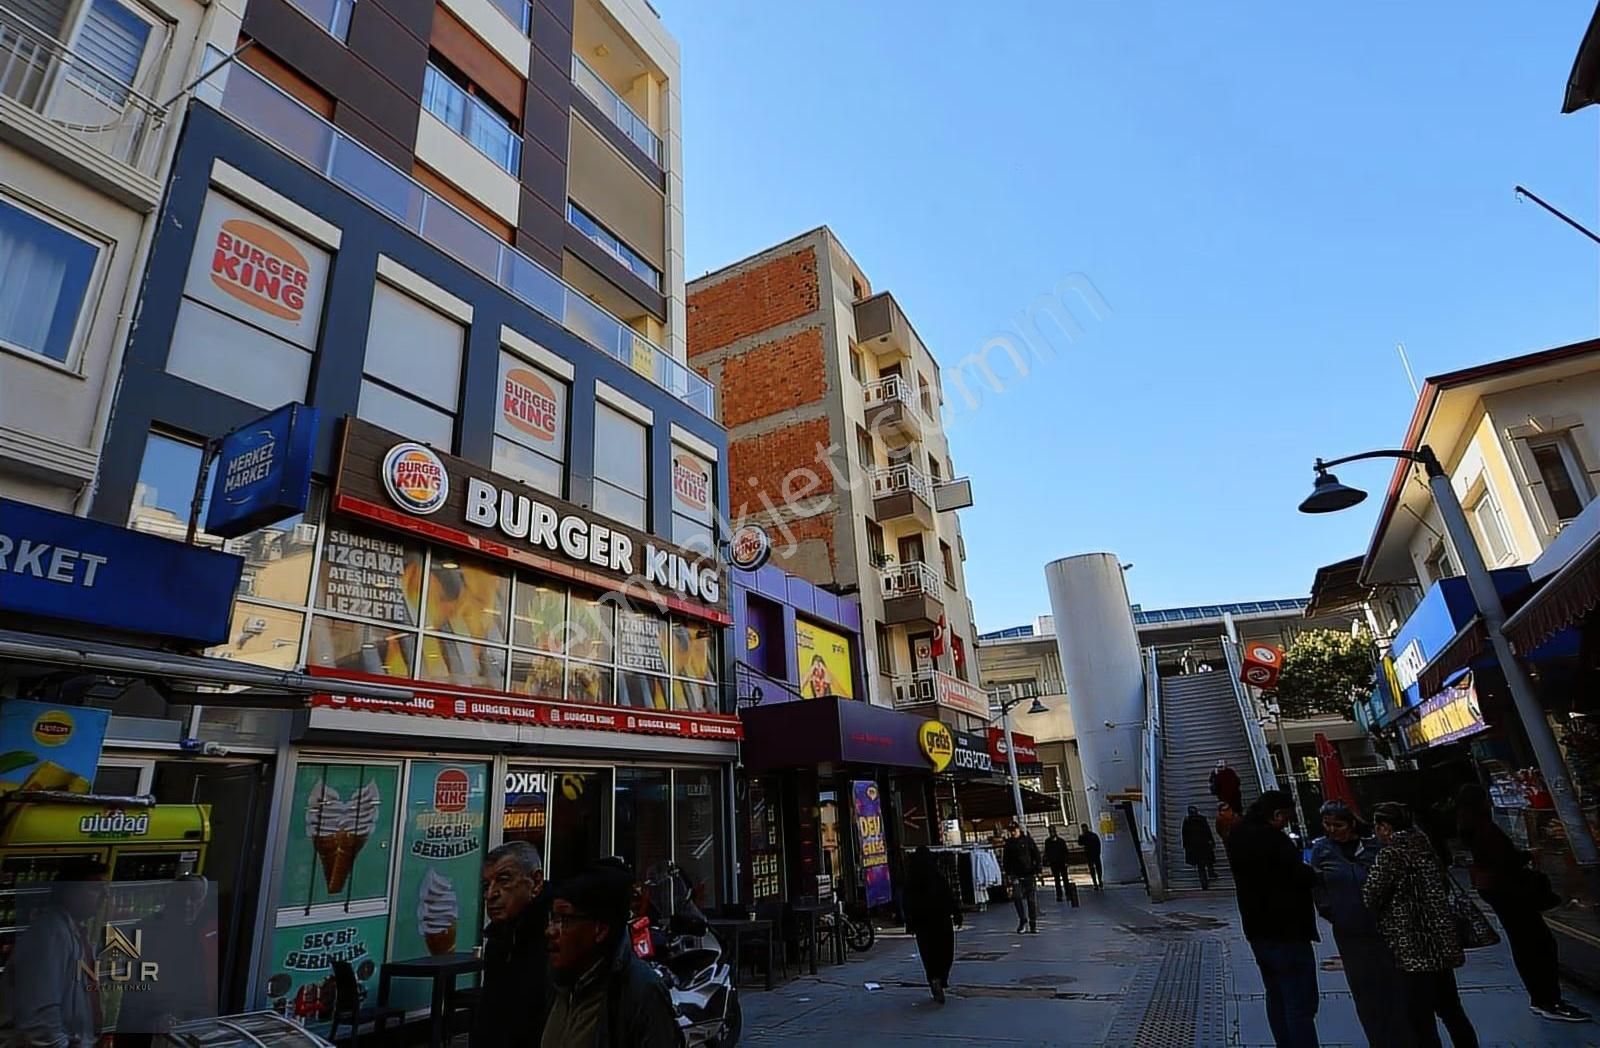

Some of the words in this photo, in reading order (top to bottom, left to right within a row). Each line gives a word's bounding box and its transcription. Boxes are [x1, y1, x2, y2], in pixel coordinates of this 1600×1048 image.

[217, 231, 307, 289] BURGER
[212, 249, 305, 309] KING
[505, 379, 556, 416] BURGER
[504, 394, 556, 432] KING
[227, 441, 276, 476] MERKEZ
[397, 461, 441, 476] BURGER
[224, 459, 273, 494] MARKET
[396, 473, 442, 490] KING
[673, 474, 707, 504] KING
[466, 476, 633, 575] BURGER
[645, 542, 720, 604] KING
[327, 544, 404, 574] IZGARA
[326, 595, 405, 622] LEZZETE
[471, 703, 511, 716] BURGER
[512, 707, 535, 718] KING
[436, 791, 467, 804] KING
[427, 826, 453, 842] SEÇ
[304, 932, 334, 951] SEÇ
